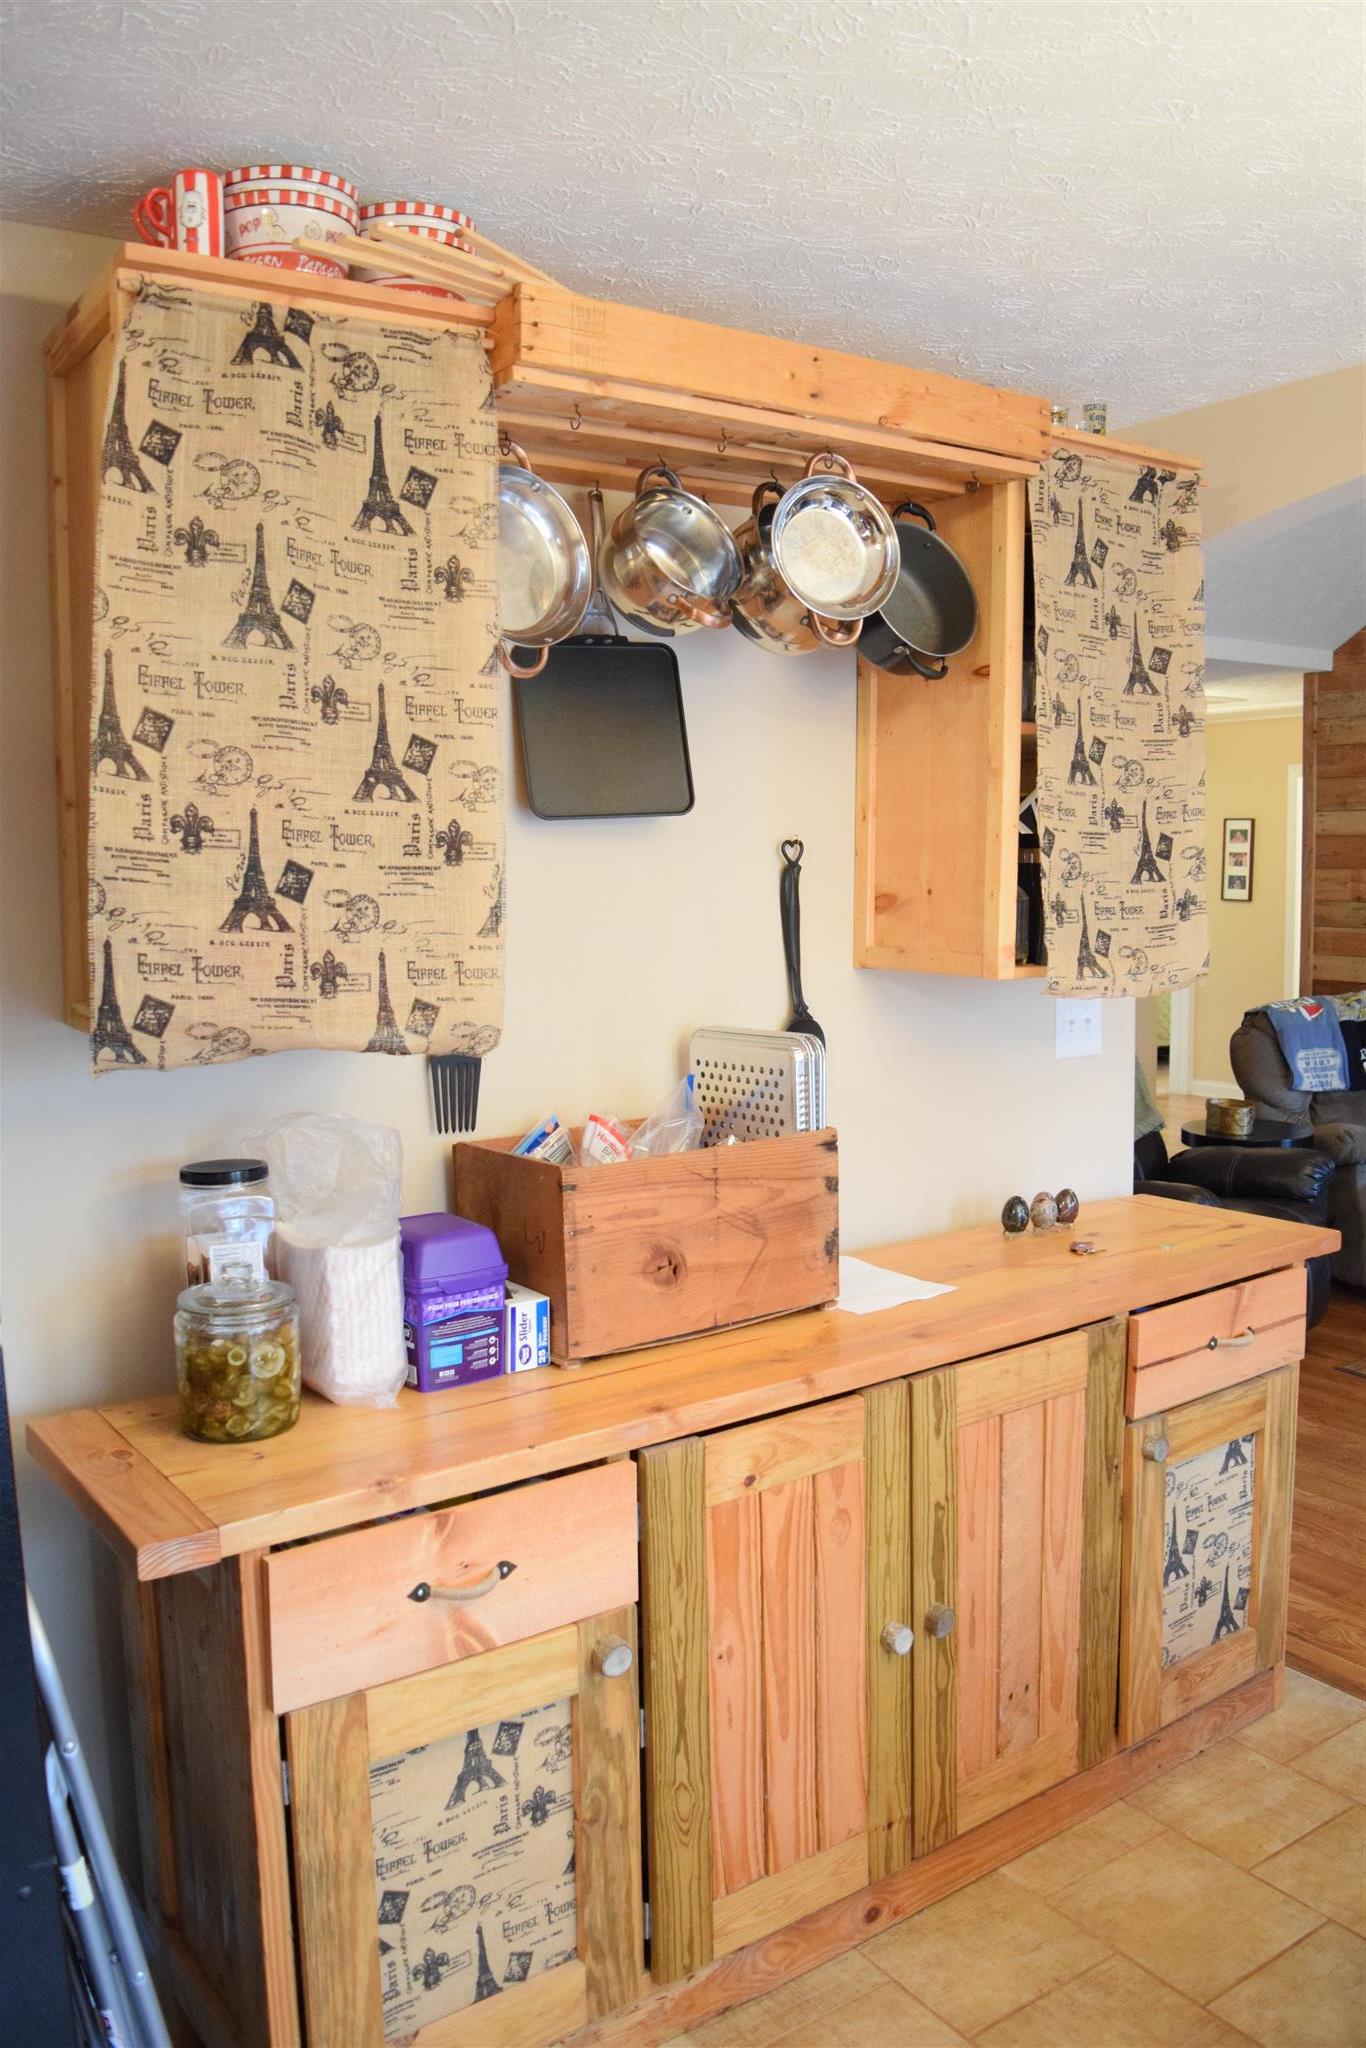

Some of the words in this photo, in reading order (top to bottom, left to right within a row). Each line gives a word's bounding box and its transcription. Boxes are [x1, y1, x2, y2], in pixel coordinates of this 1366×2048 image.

[286, 381, 304, 429] Paris
[136, 506, 158, 552] Paris
[400, 548, 420, 592] Paris
[279, 664, 298, 710] Paris
[133, 794, 154, 842] Paris
[402, 813, 421, 857] Paris
[276, 944, 296, 989] Paris
[519, 1311, 528, 1342] Slider
